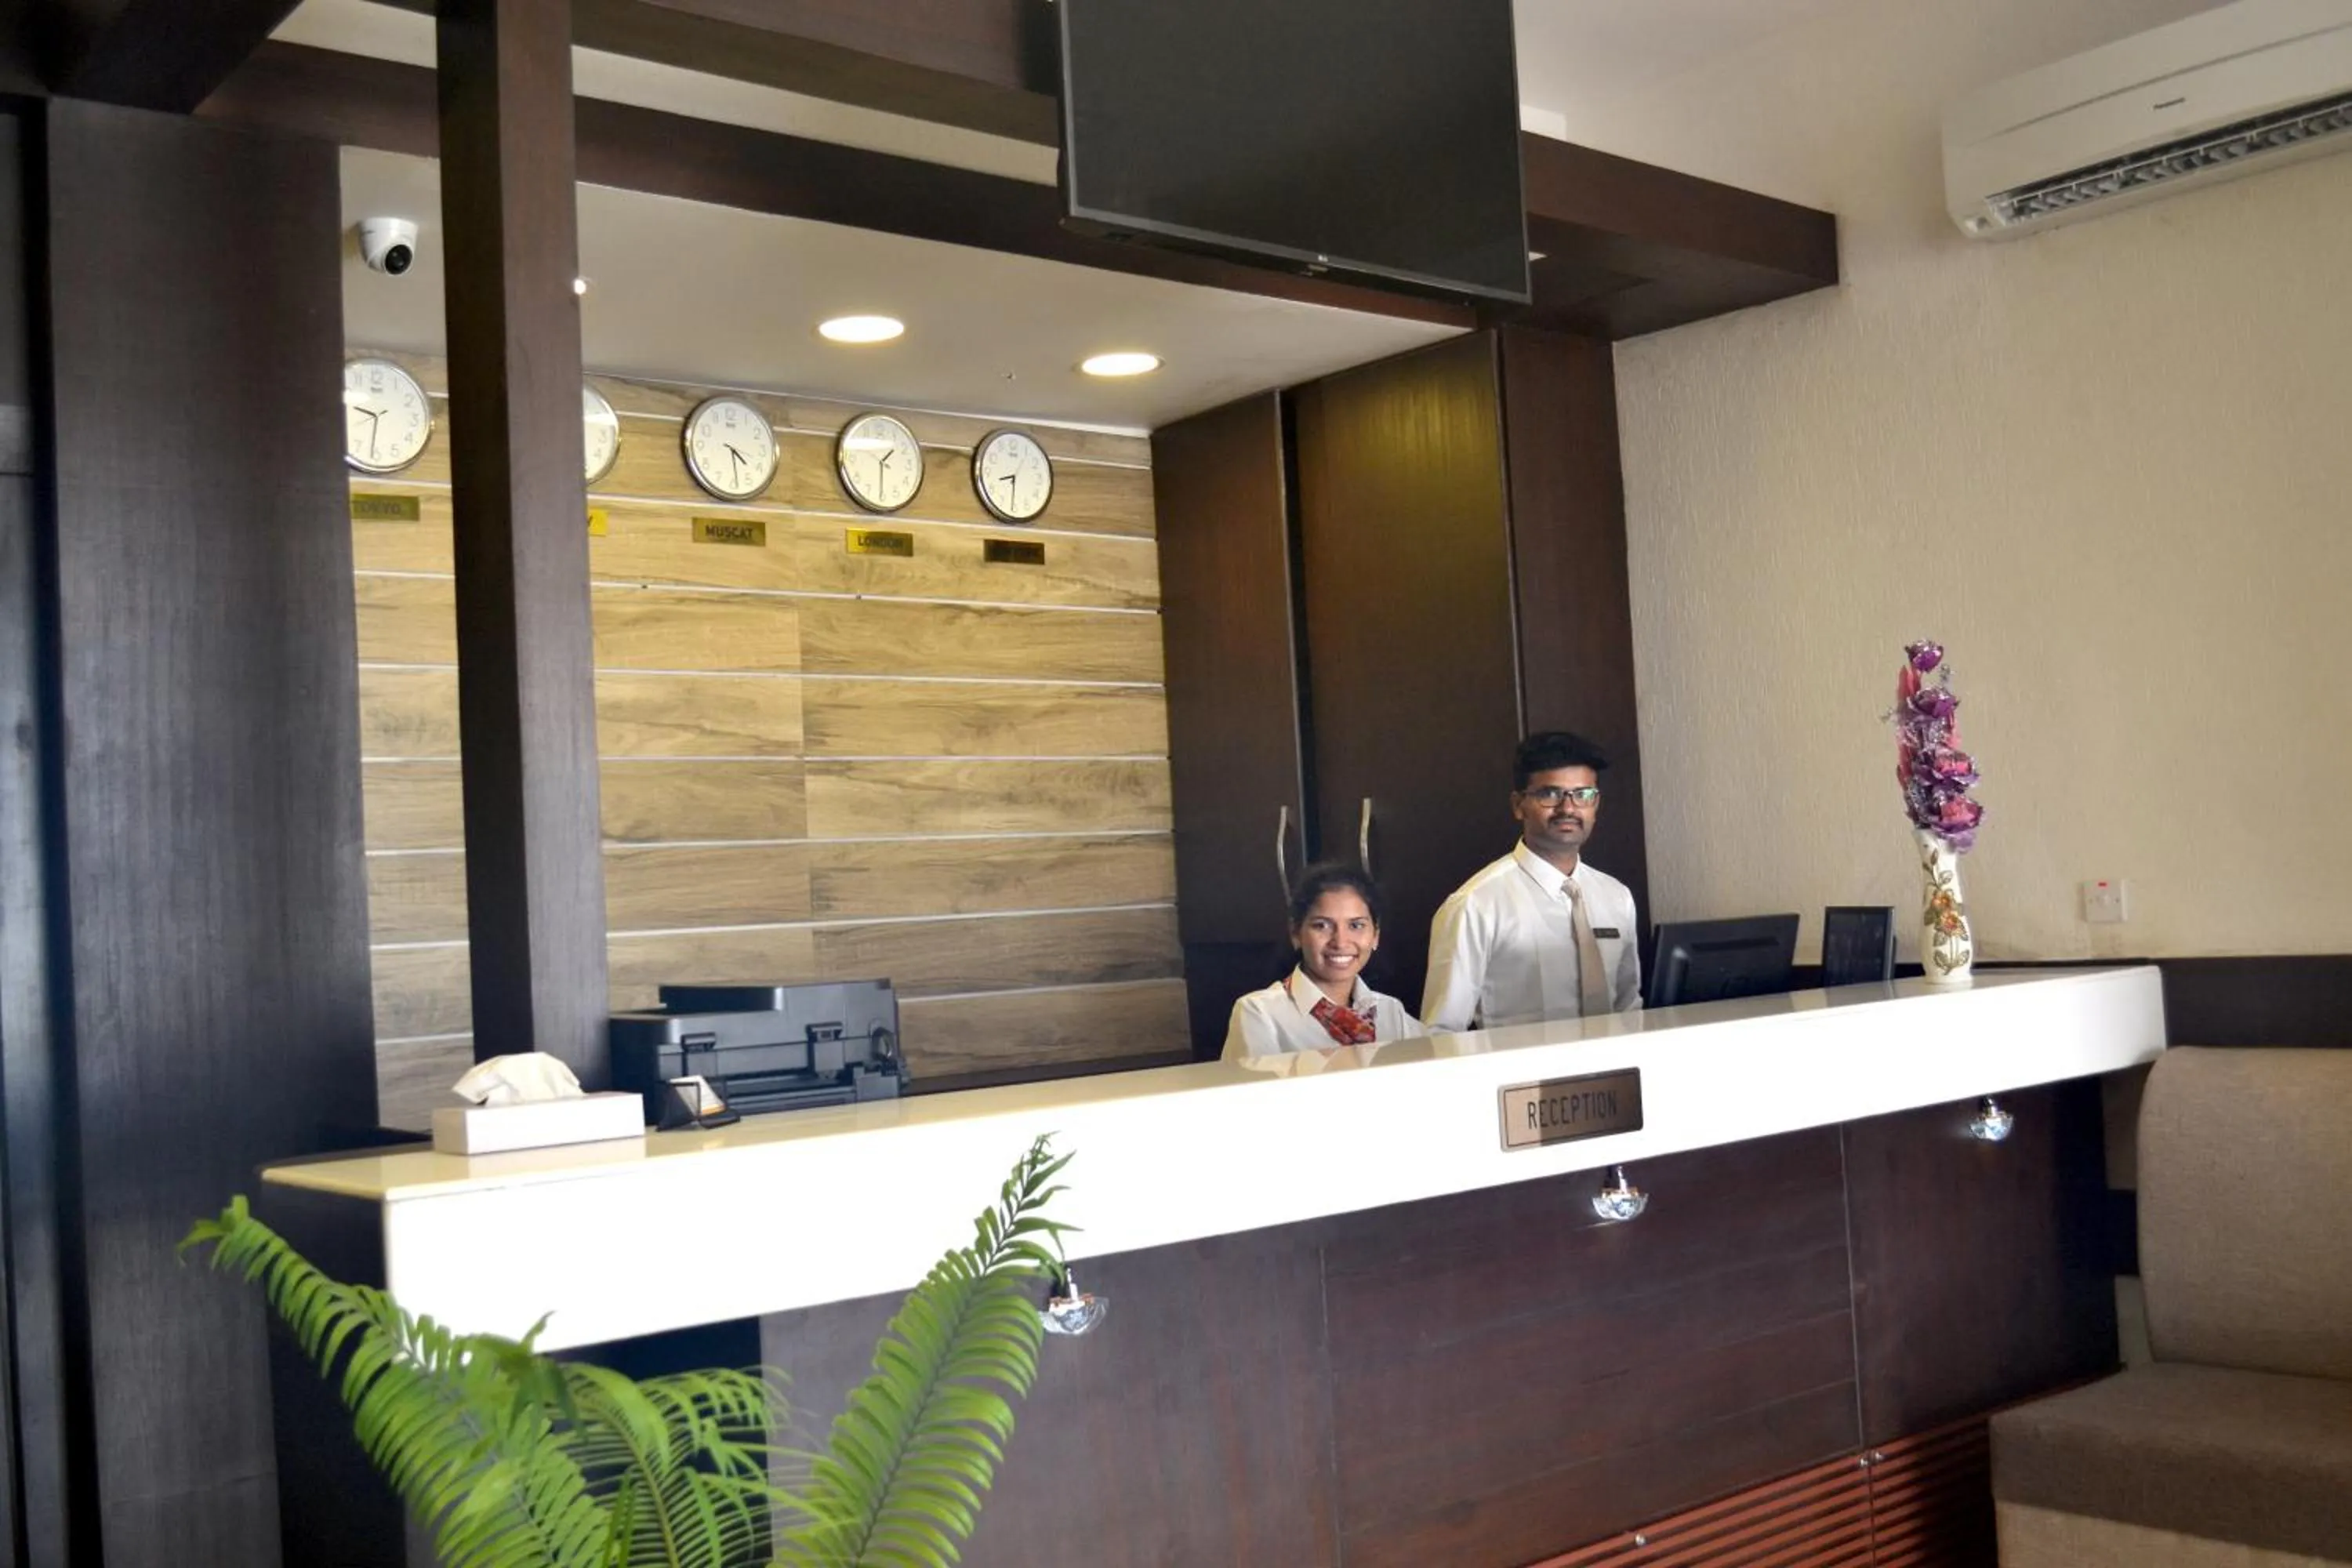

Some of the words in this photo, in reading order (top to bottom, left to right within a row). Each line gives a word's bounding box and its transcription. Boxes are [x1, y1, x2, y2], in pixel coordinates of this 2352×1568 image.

[405, 393, 415, 408] 2
[410, 413, 419, 428] 3
[404, 432, 413, 445] 4
[753, 426, 761, 440] 2
[390, 443, 400, 457] 5
[705, 524, 754, 539] MUSCAT
[857, 536, 904, 548] LONDON
[1526, 1090, 1617, 1130] RECEPTION
